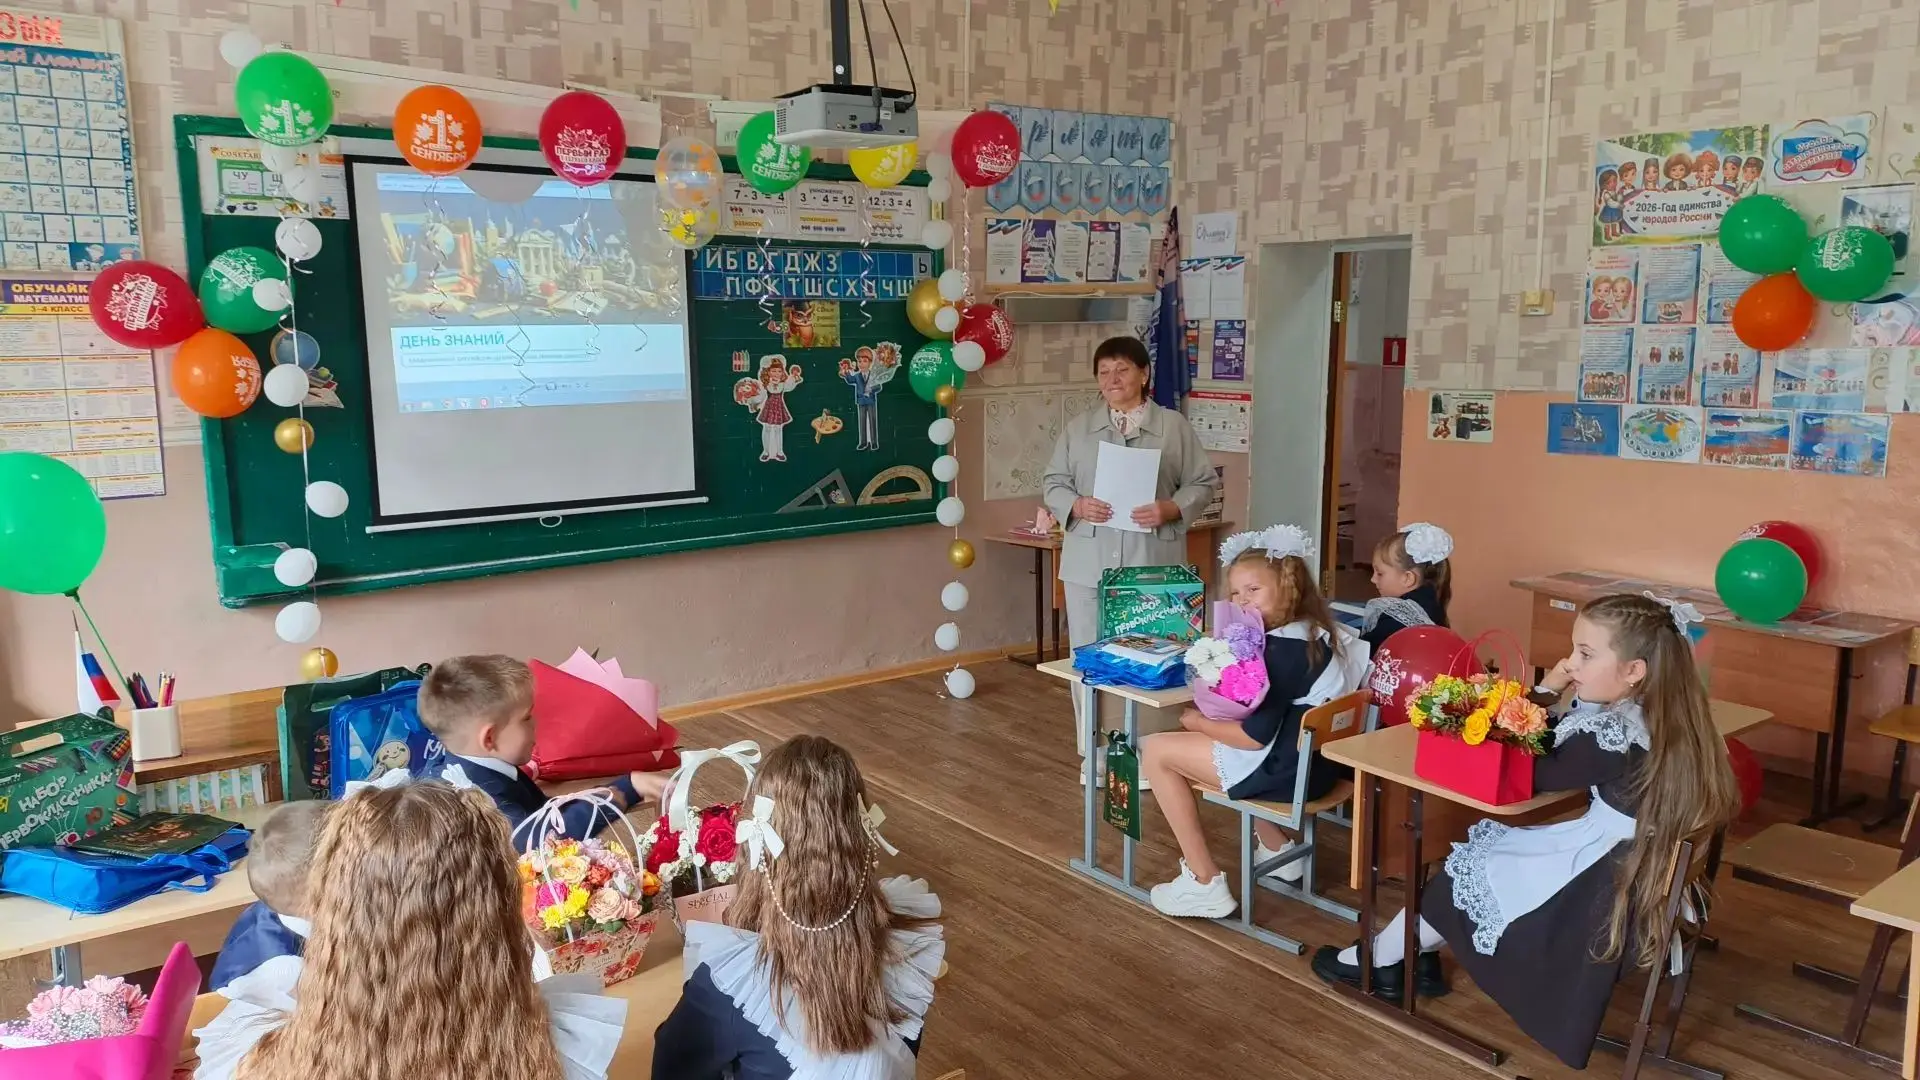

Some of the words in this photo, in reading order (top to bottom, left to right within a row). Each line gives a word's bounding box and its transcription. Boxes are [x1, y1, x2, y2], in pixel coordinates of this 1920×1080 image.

[428, 109, 453, 151] 1
[410, 144, 468, 162] СЕНТЯБРЯ
[556, 146, 592, 157] ПЕРВЫЙ
[594, 148, 610, 157] РАЗ
[233, 171, 249, 180] ЧУ
[734, 189, 741, 199] 7
[751, 190, 758, 201] 3
[778, 193, 785, 201] 4
[800, 193, 807, 202] 3
[822, 194, 829, 203] 4
[842, 196, 854, 205] 12
[869, 197, 880, 206] 12
[889, 198, 895, 207] 3
[906, 199, 912, 208] 4
[1635, 202, 1677, 213] 2026-Год
[1679, 200, 1722, 212] единства
[1642, 215, 1678, 225] народов
[1680, 213, 1712, 222] России
[726, 251, 738, 270] Б
[747, 251, 758, 271] В
[784, 252, 800, 273] Д
[803, 253, 821, 272] Ж
[826, 254, 838, 272] З
[11, 282, 88, 293] ОБУЧАЙК
[726, 276, 740, 296] П
[745, 277, 761, 296] Ф
[766, 278, 781, 296] К
[788, 278, 800, 296] Т
[804, 278, 822, 296] Ш
[826, 279, 839, 297] С
[845, 278, 859, 297] Х
[883, 279, 893, 297] Ч
[51, 305, 83, 313] КЛАСС
[400, 334, 440, 350] ДЕНЬ
[444, 330, 505, 347] ЗНАНИЙ
[1132, 600, 1160, 614] НАБОР
[1115, 604, 1186, 635] ПЕРВОКЛАССНИКА
[1380, 672, 1398, 688] РАЗ
[18, 775, 67, 813] НАБОР
[687, 891, 729, 909] SPECIAL
